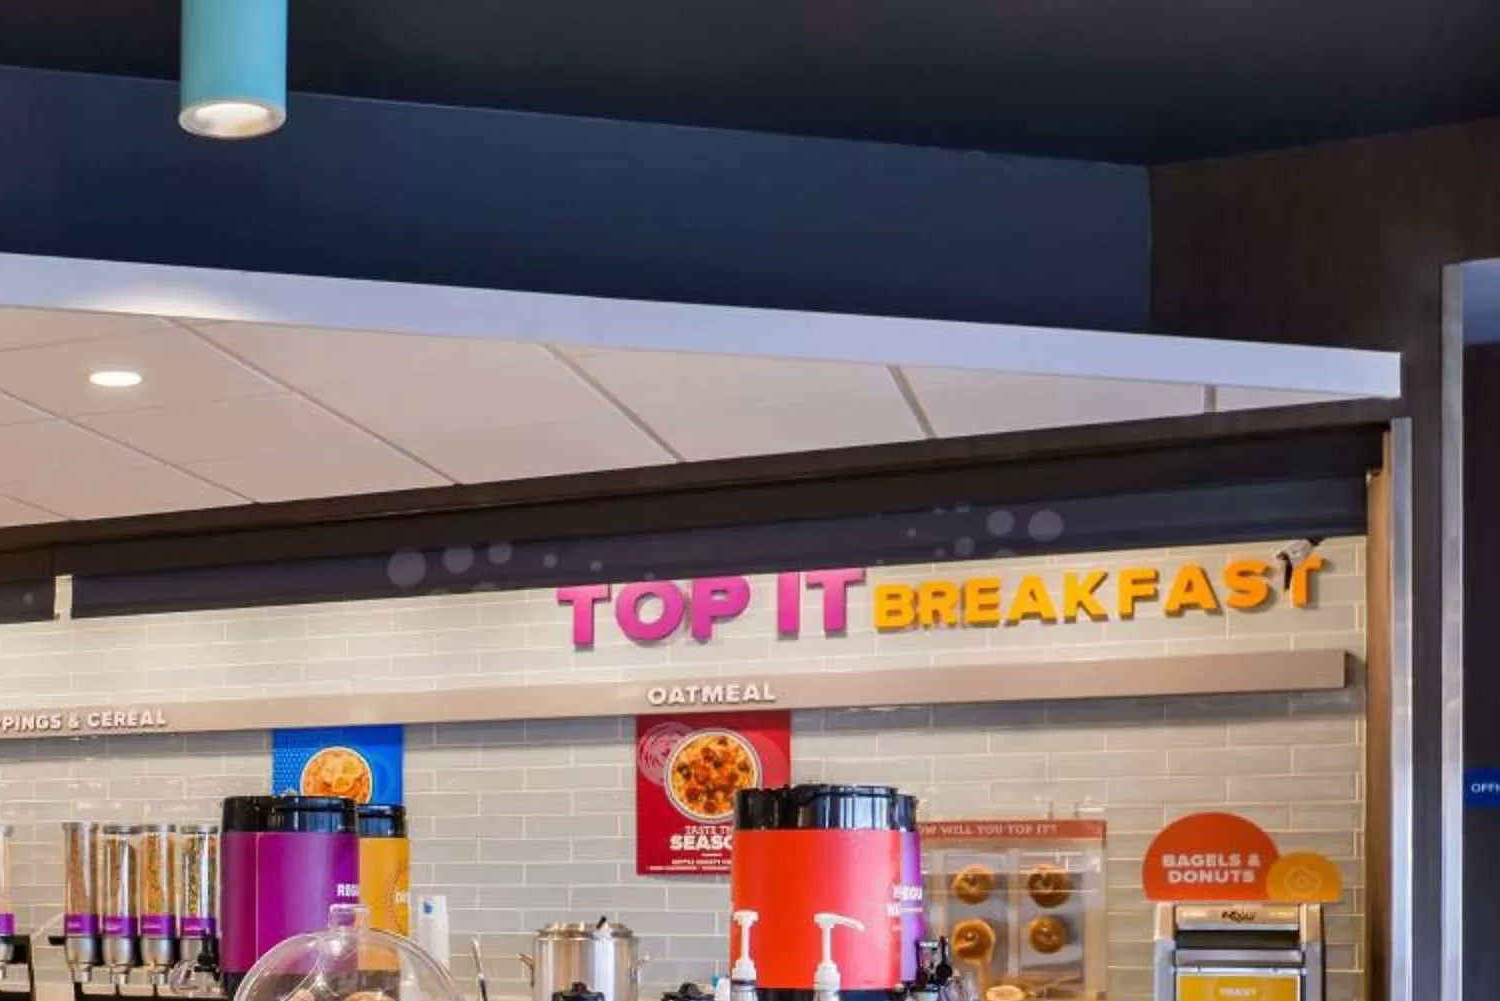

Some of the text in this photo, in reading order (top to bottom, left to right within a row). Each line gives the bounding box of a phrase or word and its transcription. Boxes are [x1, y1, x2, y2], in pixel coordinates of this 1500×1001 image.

[556, 555, 1327, 648] TOP IT BREAKFAST
[646, 681, 777, 705] OATMEAL
[67, 713, 82, 730] &
[88, 708, 169, 729] CEREAL
[1471, 783, 1500, 793] OFFI
[977, 823, 1003, 835] YOU
[1007, 823, 1033, 835] TOP
[669, 834, 733, 851] SEASO
[1162, 853, 1261, 868] BAGELS &
[1167, 869, 1256, 884] DONUTS
